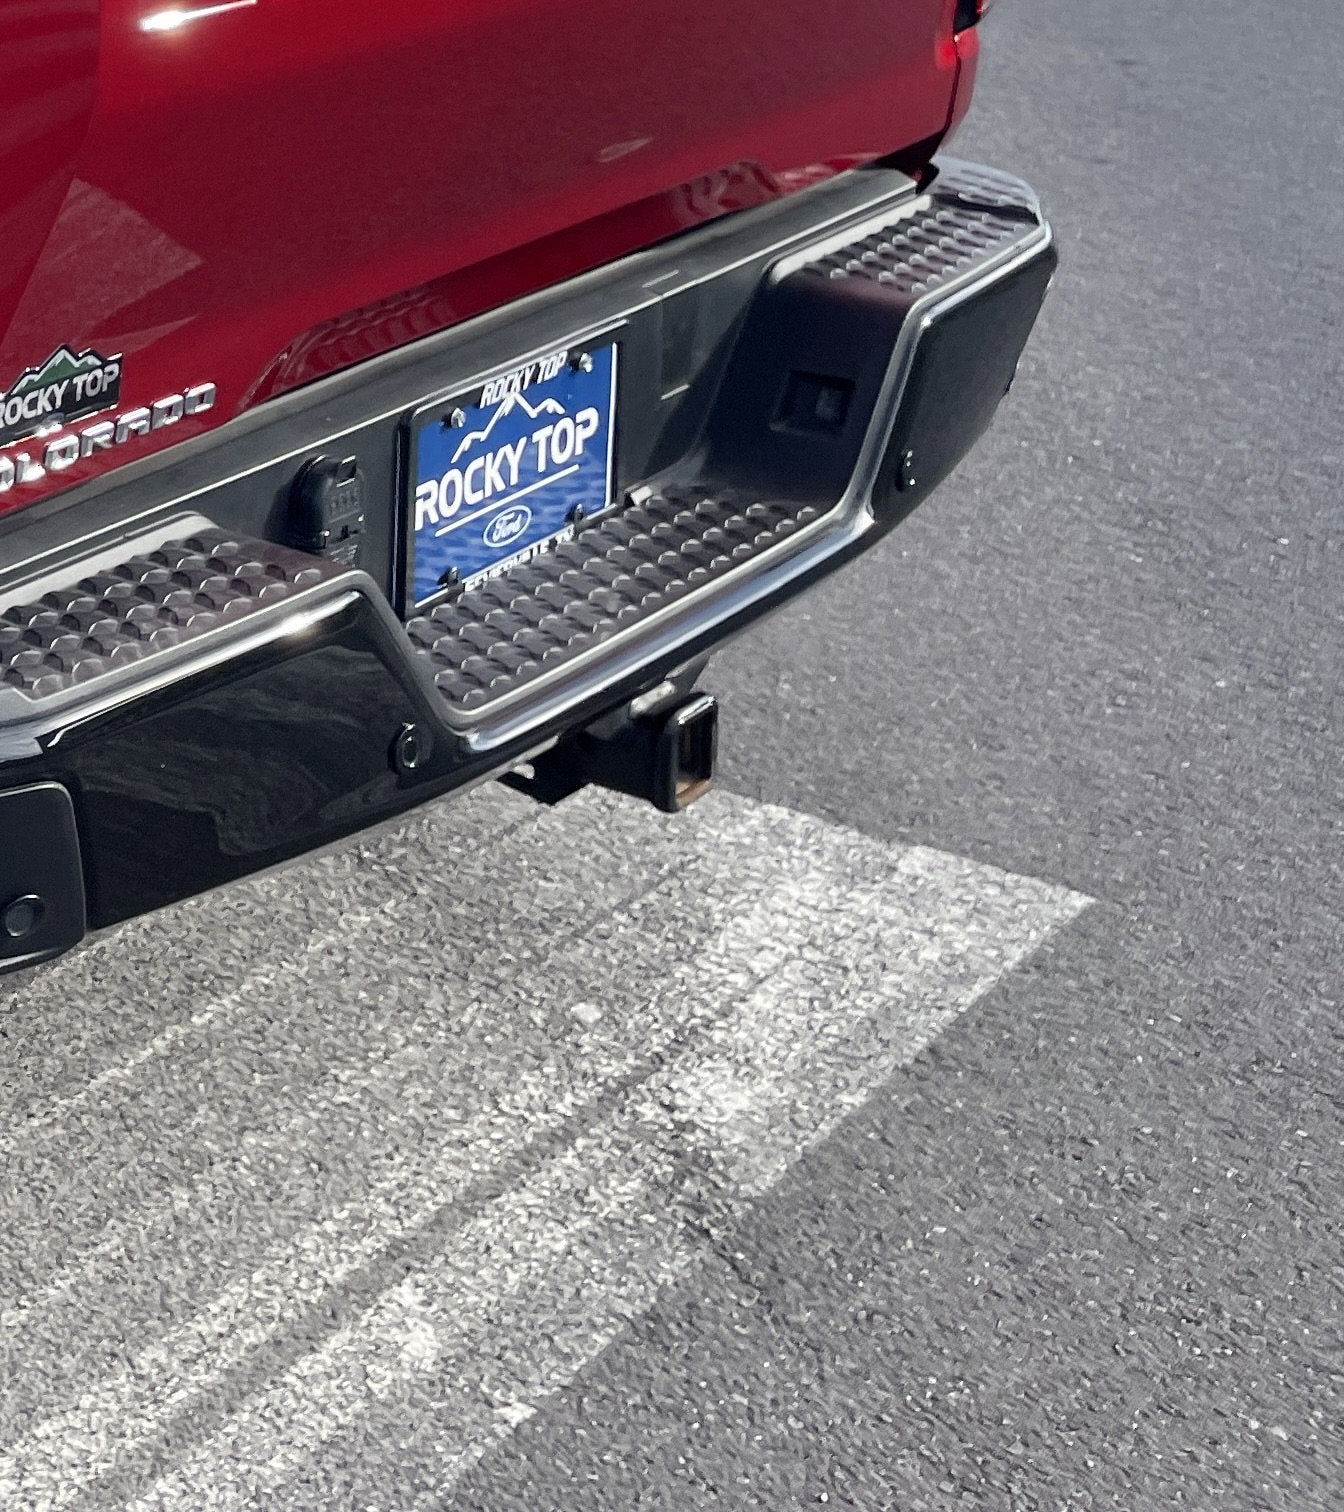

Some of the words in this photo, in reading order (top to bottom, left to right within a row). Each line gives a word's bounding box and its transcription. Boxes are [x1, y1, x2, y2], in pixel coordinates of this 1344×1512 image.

[71, 361, 120, 403] TOP
[479, 365, 535, 409] ROCKY
[536, 351, 568, 385] TOP
[414, 435, 529, 532] ROCKY
[531, 406, 600, 474] TOP
